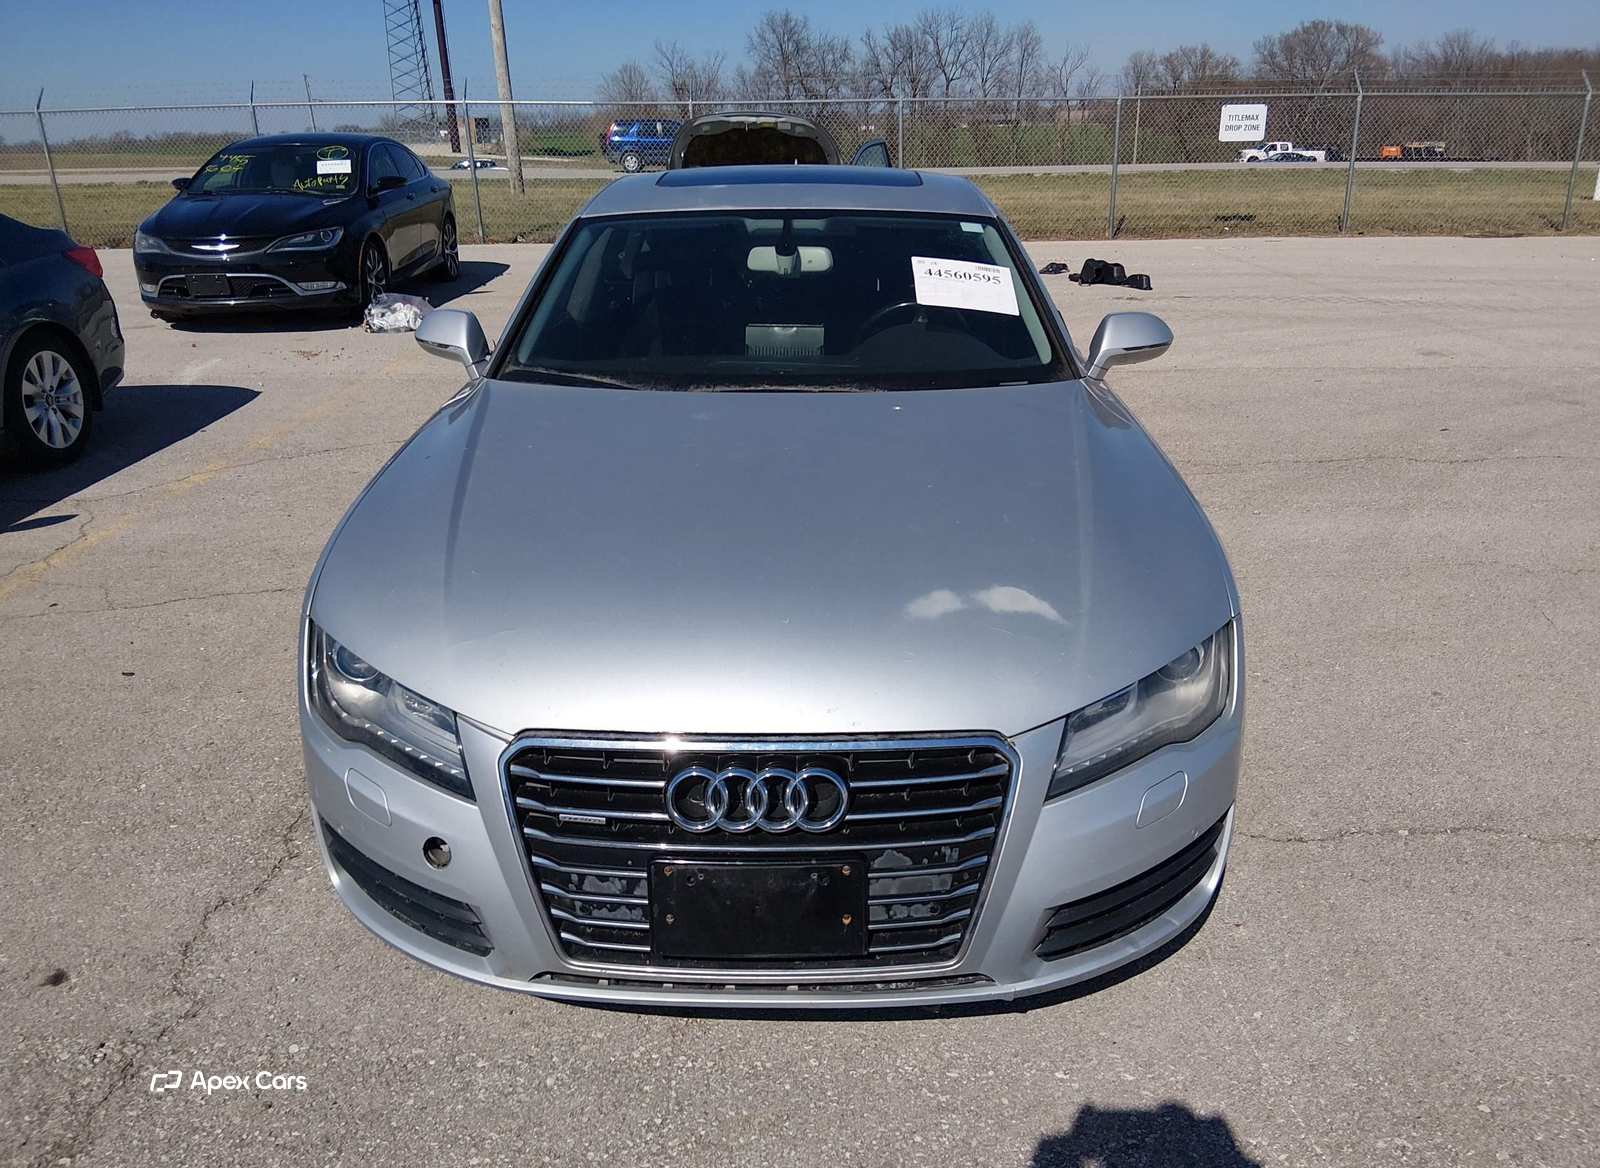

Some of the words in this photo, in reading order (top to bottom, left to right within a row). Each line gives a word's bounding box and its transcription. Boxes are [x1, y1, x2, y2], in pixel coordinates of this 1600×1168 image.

[1228, 114, 1260, 122] TITLEMAX
[1224, 124, 1242, 132] DROP
[1244, 124, 1261, 132] ZONE
[923, 268, 1002, 285] 44560595
